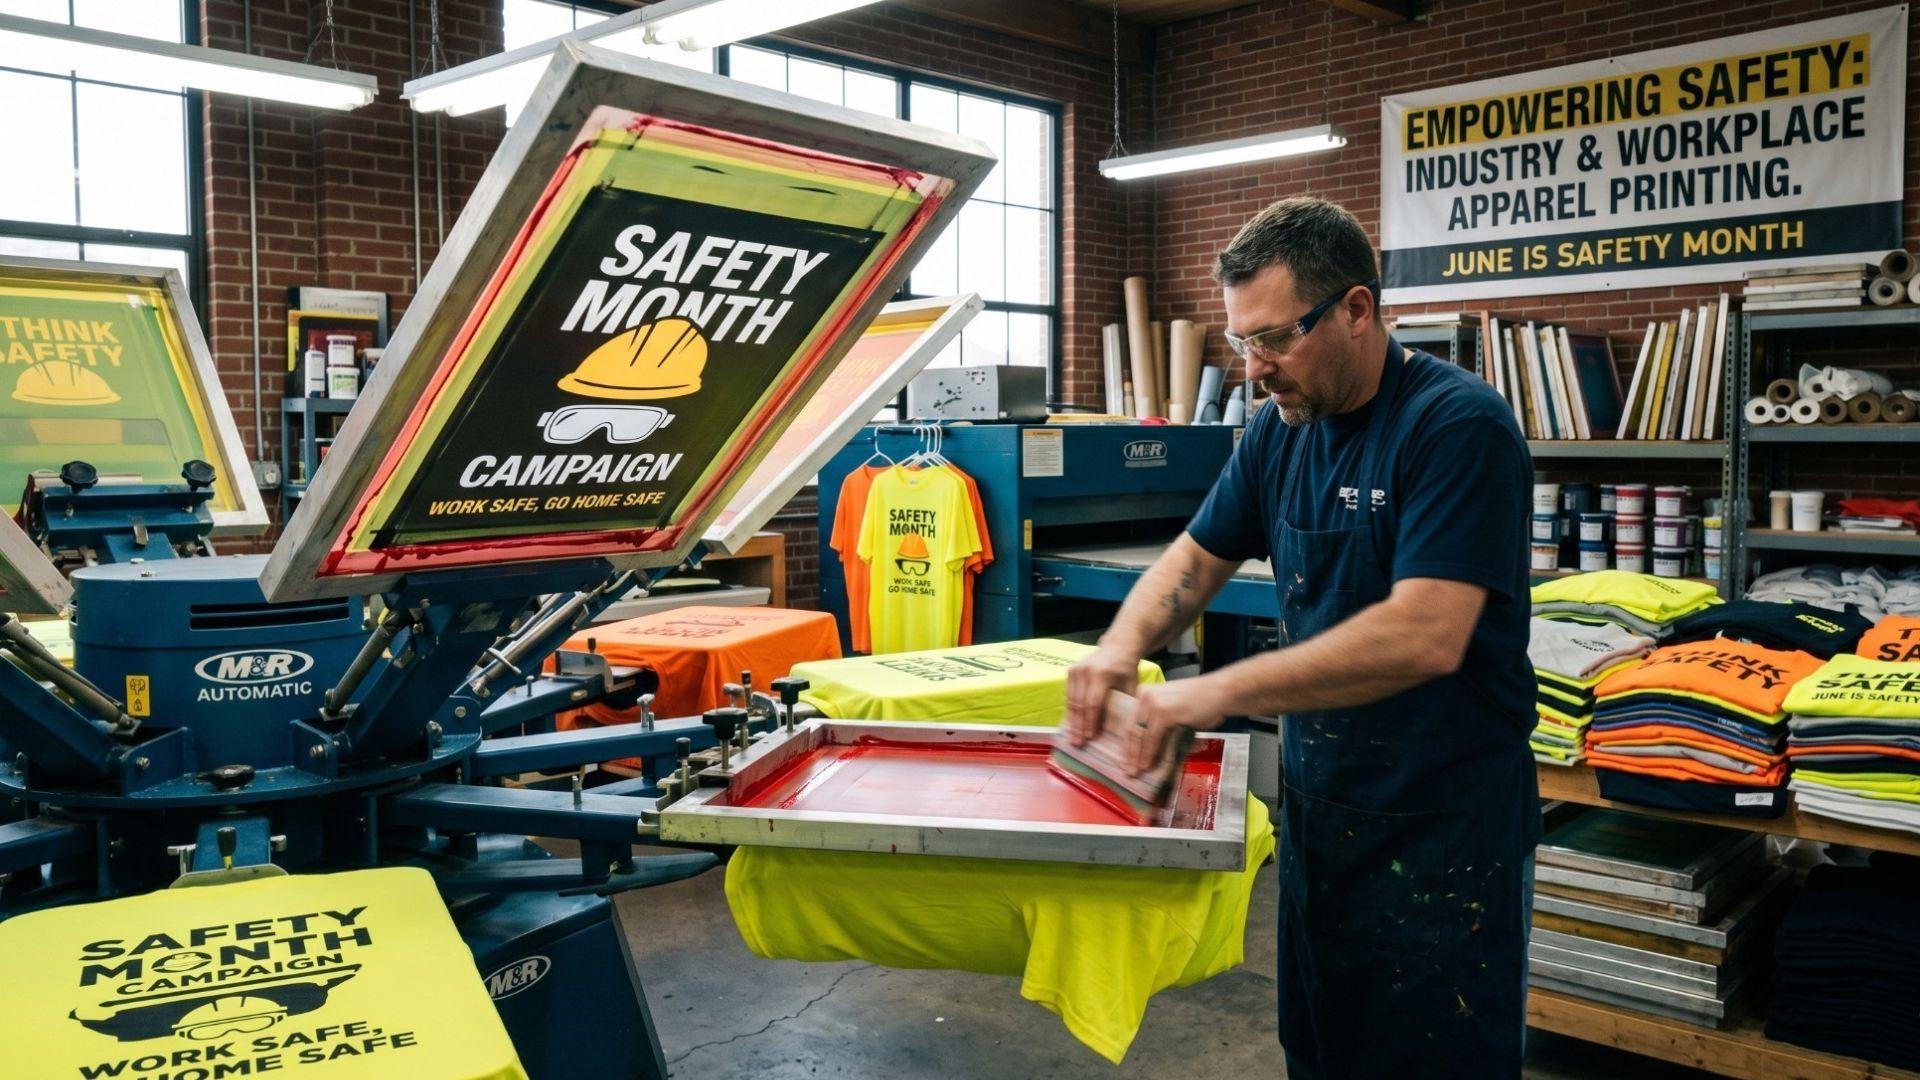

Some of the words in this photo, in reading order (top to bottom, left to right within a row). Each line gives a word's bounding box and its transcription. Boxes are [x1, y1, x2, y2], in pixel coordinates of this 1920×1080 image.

[1407, 73, 1660, 150] EMPOWERING
[1678, 41, 1864, 110] SAFETY:
[1405, 138, 1564, 193] INDUSTRY
[1577, 134, 1603, 173] &
[1617, 96, 1866, 168] WORKPLACE
[1447, 182, 1597, 231] APPAREL
[1610, 156, 1803, 215] PRINTING.
[599, 224, 831, 295] SAFETY
[1442, 248, 1513, 277] JUNE
[1524, 244, 1549, 271] IS
[1558, 233, 1673, 268] SAFETY
[1683, 221, 1804, 258] MONTH
[559, 279, 794, 345] MONTH
[0, 316, 120, 344] THINK
[0, 341, 123, 367] AFETY
[459, 453, 684, 488] CAMPAIGN
[428, 499, 490, 516] WORK
[489, 497, 540, 514] SAFE,
[544, 496, 572, 511] GO
[571, 493, 620, 509] HOME
[620, 491, 665, 506] SAFE
[889, 509, 936, 524] SAFETY
[889, 523, 936, 538] MONTH
[888, 585, 900, 593] GO
[914, 579, 931, 587] SAFE
[217, 653, 294, 679] M&R
[196, 681, 312, 702] AUTOMATIC
[1811, 692, 1848, 701] JUNE
[1850, 692, 1864, 700] IS
[78, 905, 369, 962] SAFETY
[79, 927, 373, 988] MONTH
[116, 952, 345, 996] CAMPAIGN
[490, 959, 539, 998] M&R
[78, 1042, 237, 1080] WORK
[250, 1021, 383, 1054] SAFE,
[297, 1031, 419, 1065] SAFE
